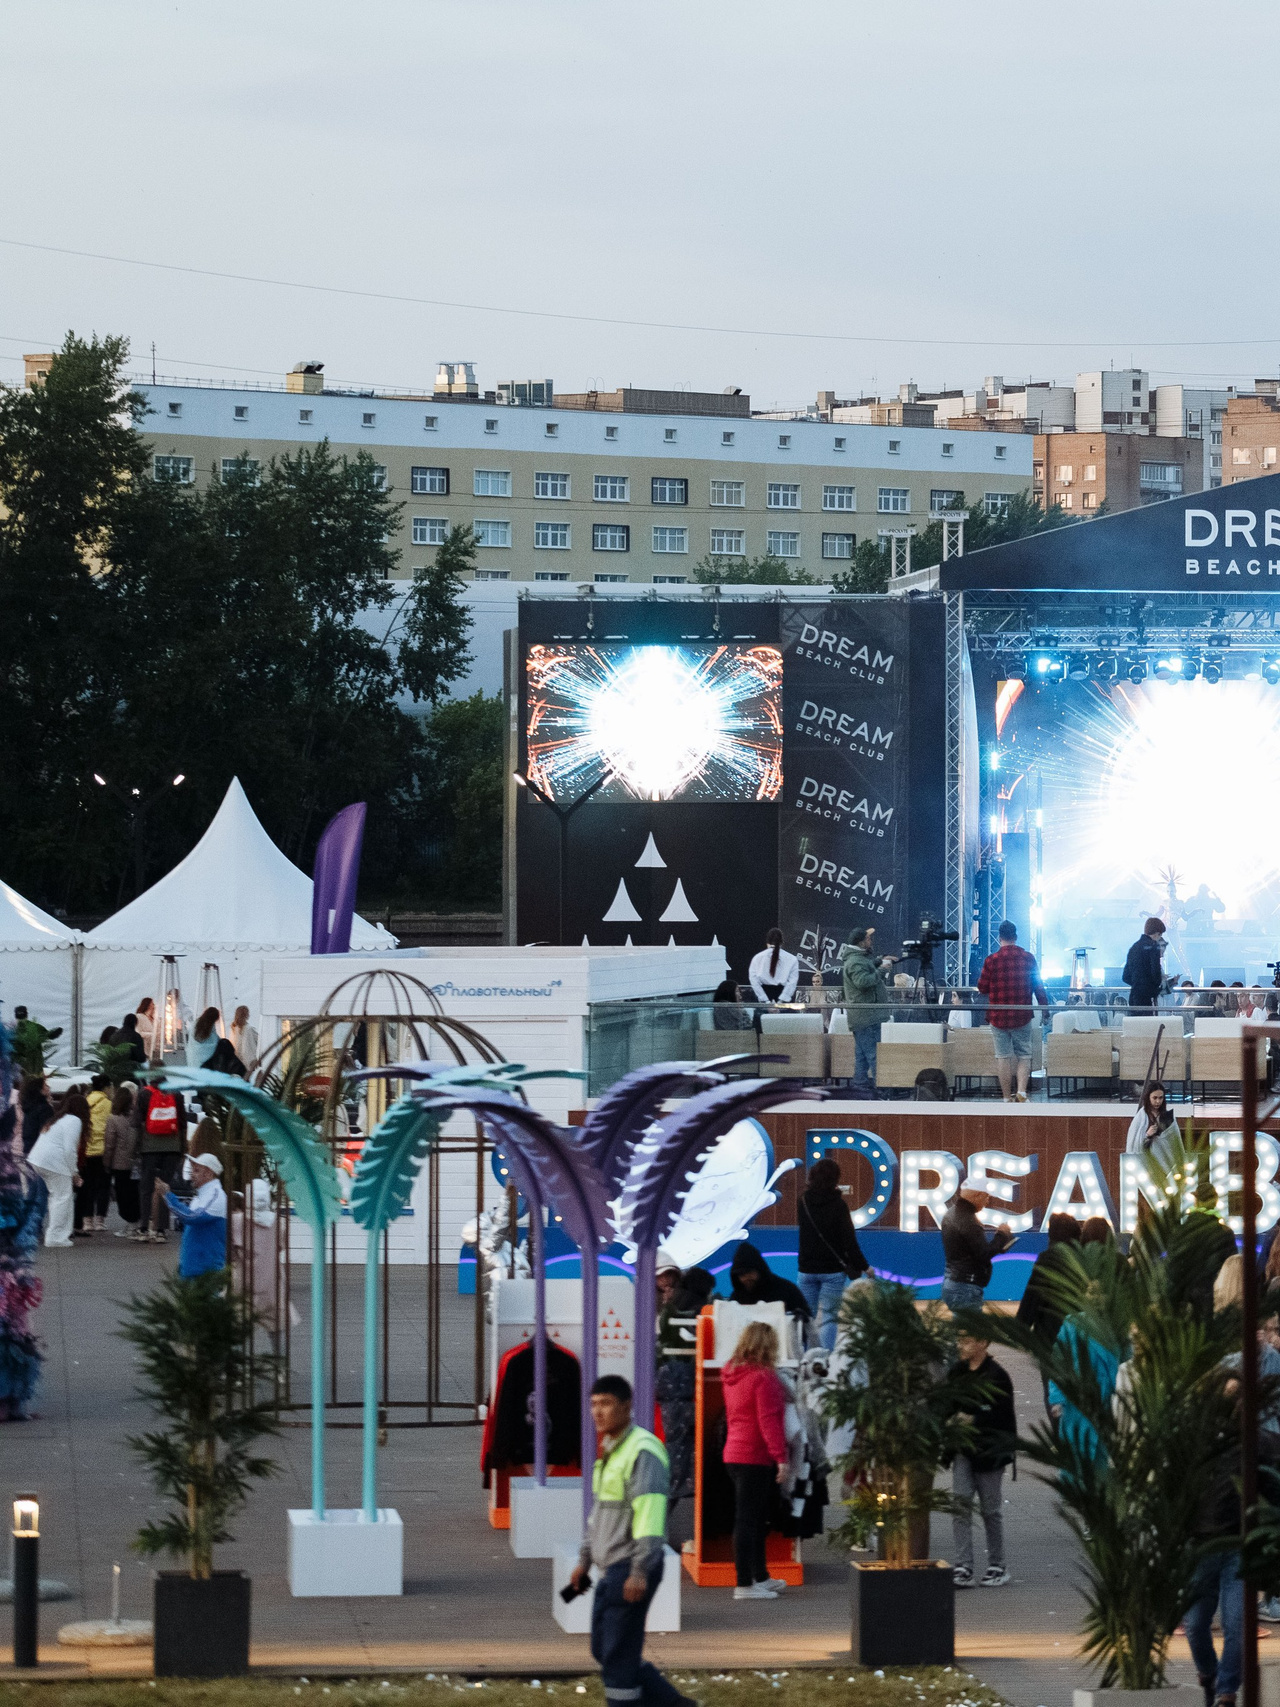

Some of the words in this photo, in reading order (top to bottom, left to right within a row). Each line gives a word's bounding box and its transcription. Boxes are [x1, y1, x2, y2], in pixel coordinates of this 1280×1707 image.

[796, 646, 842, 669] BEACH
[849, 666, 885, 685] CLUB
[799, 623, 895, 673] DREAM
[796, 723, 842, 746] BEACH
[849, 742, 885, 761] CLUB
[799, 700, 894, 749] DREAM
[795, 799, 842, 822] BEACH
[849, 819, 885, 838] CLUB
[799, 776, 894, 826] DREAM
[795, 876, 842, 898] BEACH
[849, 896, 885, 914] CLUB
[799, 853, 894, 902] DREAM
